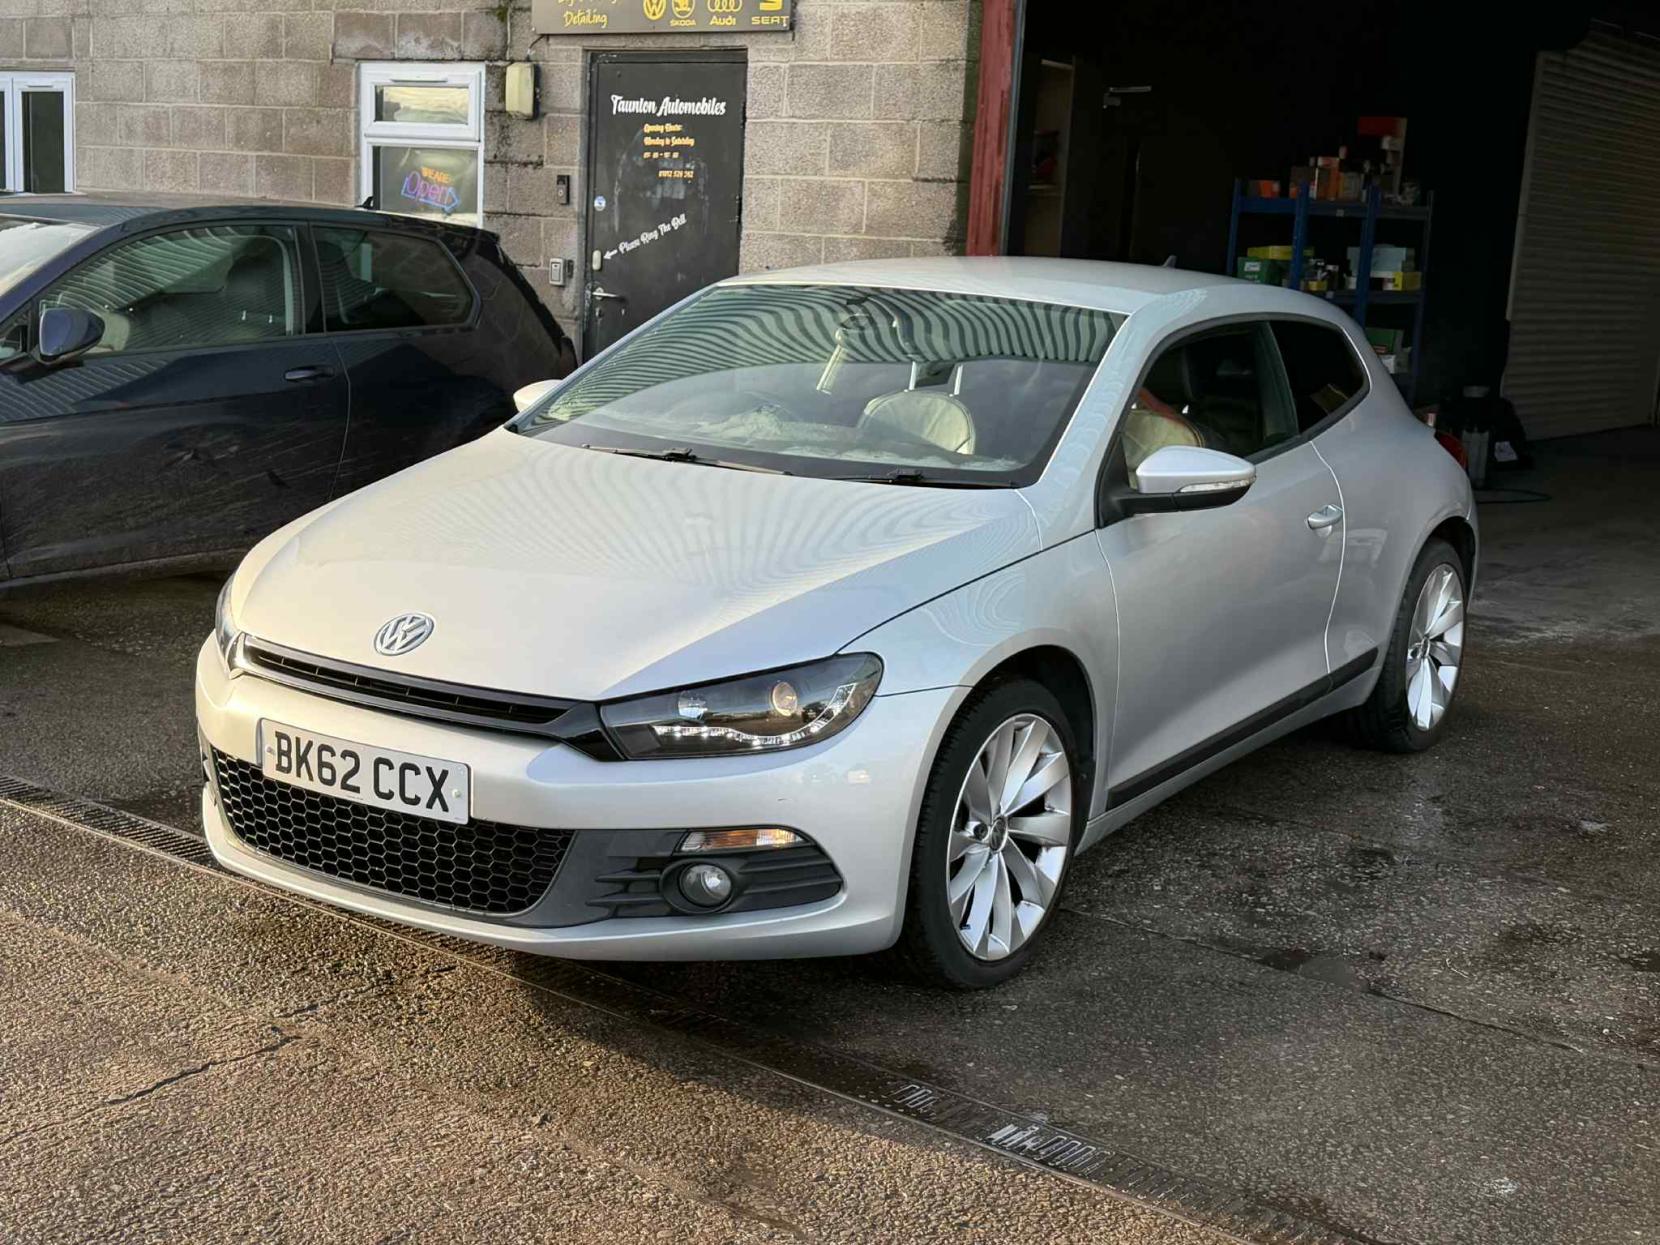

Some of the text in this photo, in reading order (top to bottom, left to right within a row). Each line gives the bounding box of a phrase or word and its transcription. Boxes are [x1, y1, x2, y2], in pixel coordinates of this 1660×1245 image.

[563, 9, 608, 28] Detailing
[709, 15, 737, 26] Audi
[611, 94, 726, 117] Taunton Automobiles
[407, 171, 447, 204] Open
[640, 230, 659, 244] Ring
[658, 223, 671, 236] The
[671, 213, 687, 230] Bell
[274, 731, 449, 813] BK62 CCX
